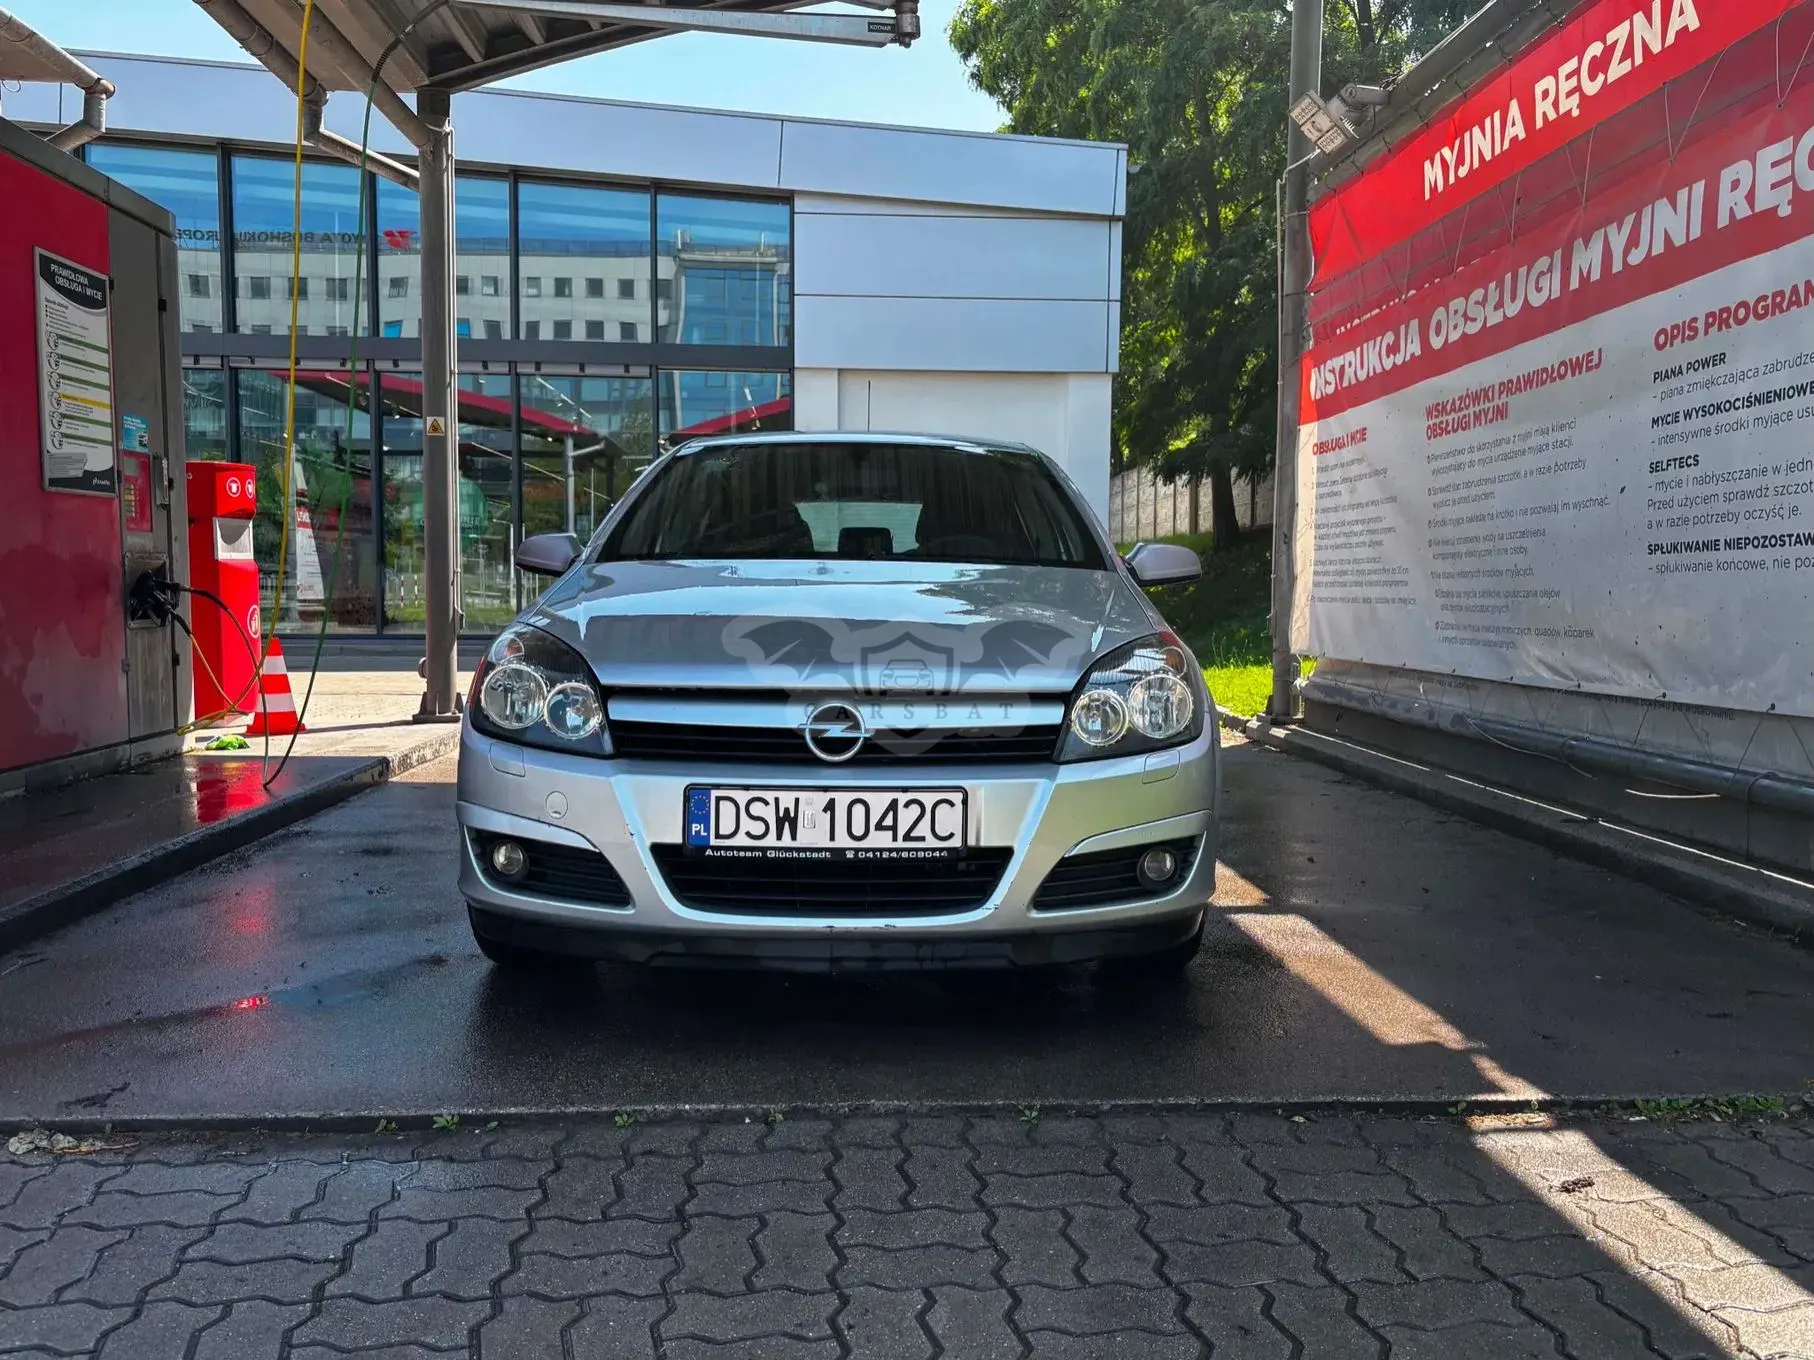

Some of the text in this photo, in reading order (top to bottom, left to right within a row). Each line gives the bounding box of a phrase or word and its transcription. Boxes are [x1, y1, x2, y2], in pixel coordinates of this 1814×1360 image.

[1424, 0, 1700, 200] MYJNIA RĘCZNA
[1310, 319, 1421, 400] INSTRUKCJA
[1429, 248, 1561, 350] OBSŁUGI
[1569, 180, 1705, 291] MYJNI
[1654, 317, 1699, 351] OPIS
[1653, 352, 1726, 384] PIANA POWER
[1660, 352, 1814, 403] piana zmiękczająca zabrudze
[1425, 348, 1603, 421] WSKAZÓWKI PRAWIDŁOWEJ
[1426, 401, 1509, 441] OBSŁUGI MYJNI
[1651, 381, 1814, 429] MYCIE WYSOKOCIŚNIENIOWE
[1552, 417, 1577, 434] klienci
[1658, 426, 1712, 446] intensywne
[1714, 416, 1750, 435] środki
[1753, 410, 1793, 429] myjące
[1554, 458, 1587, 475] potrzeby
[1648, 454, 1700, 474] SELFTECS
[1655, 476, 1683, 493] mycie
[1692, 464, 1768, 487] nabłyszczanie
[1772, 464, 1782, 475] w
[1785, 458, 1813, 476] jedn
[1561, 500, 1570, 511] im
[1647, 479, 1814, 511] Przed użyciem sprawdź szczot
[1647, 502, 1802, 530] a w razie potrzeby oczyść je.
[1647, 532, 1814, 556] SPŁUKIWANIE NIEPOZOSTAW
[1656, 557, 1713, 575] spłukiwanie
[1716, 556, 1769, 571] końcowe,
[1772, 555, 1791, 569] nie
[1540, 588, 1560, 600] olejów
[1563, 626, 1595, 639] koparek
[691, 823, 707, 836] PL
[714, 795, 956, 842] DSW 1042C
[705, 849, 762, 857] Autoteam
